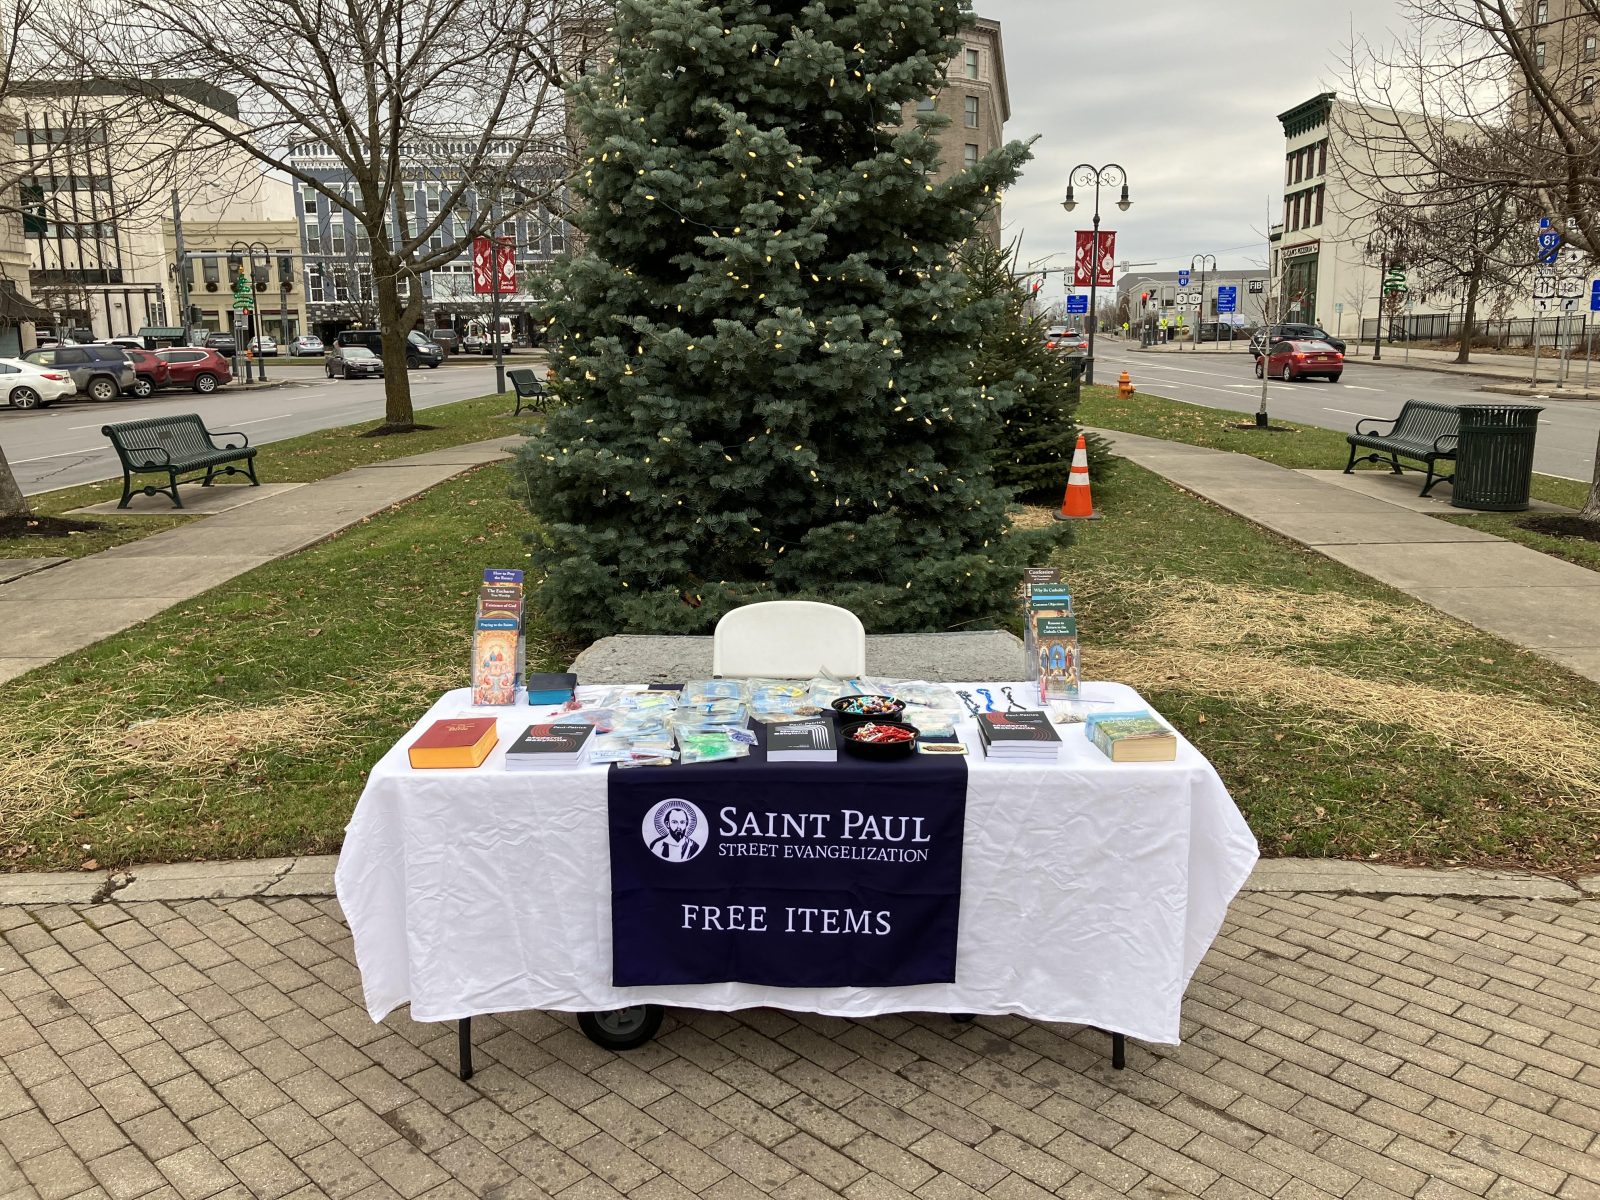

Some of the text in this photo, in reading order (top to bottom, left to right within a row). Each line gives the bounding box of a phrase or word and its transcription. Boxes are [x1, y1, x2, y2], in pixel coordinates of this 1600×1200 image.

[1544, 235, 1555, 245] 81
[1540, 282, 1549, 293] 11
[718, 843, 929, 863] STREET EVANGELIZATION
[681, 904, 892, 935] FREE ITEMS
